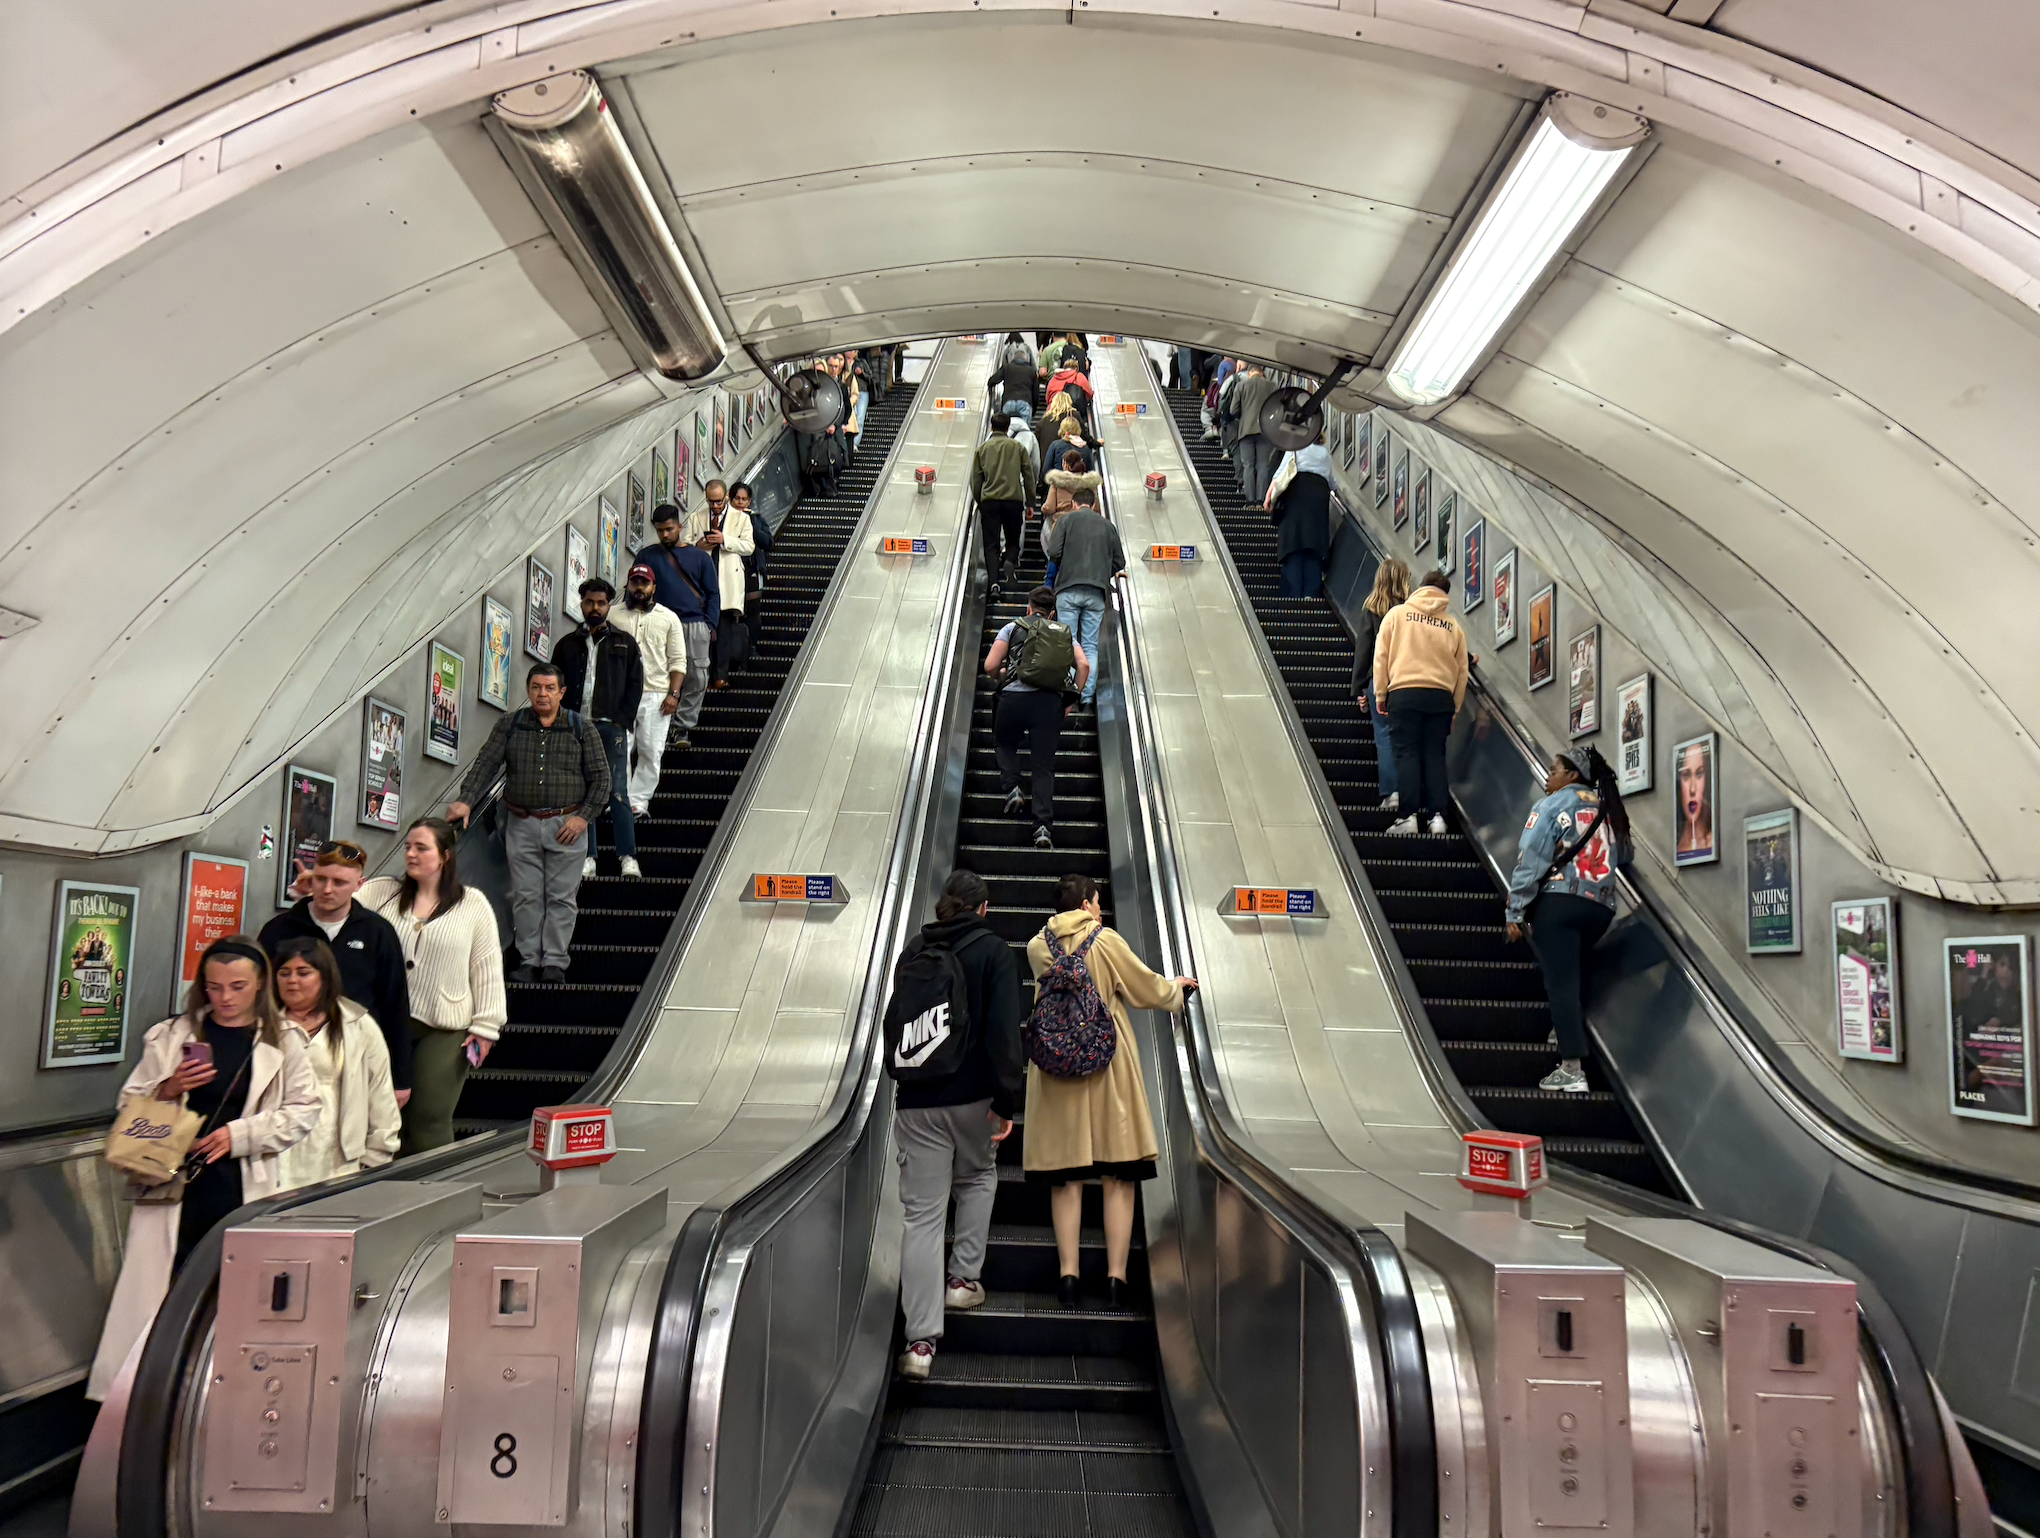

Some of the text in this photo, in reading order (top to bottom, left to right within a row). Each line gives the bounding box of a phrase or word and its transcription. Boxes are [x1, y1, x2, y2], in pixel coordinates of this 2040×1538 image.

[1406, 612, 1453, 632] SUPREME
[442, 658, 455, 675] ideal
[220, 888, 237, 900] bank
[1752, 888, 1788, 904] NOTHING
[83, 894, 108, 916] BACK!
[196, 899, 234, 912] that makes
[1753, 903, 1788, 917] FEELS LIKE
[193, 913, 235, 926] my business
[205, 926, 223, 938] their
[1953, 954, 1991, 963] The Hall
[81, 985, 110, 1001] TOWERS
[901, 1002, 950, 1053] NIKE
[1960, 1091, 1986, 1102] PLACES
[535, 1123, 547, 1136] STO
[571, 1123, 602, 1138] STOP
[1472, 1149, 1505, 1164] STOP
[490, 1432, 517, 1479] 8
